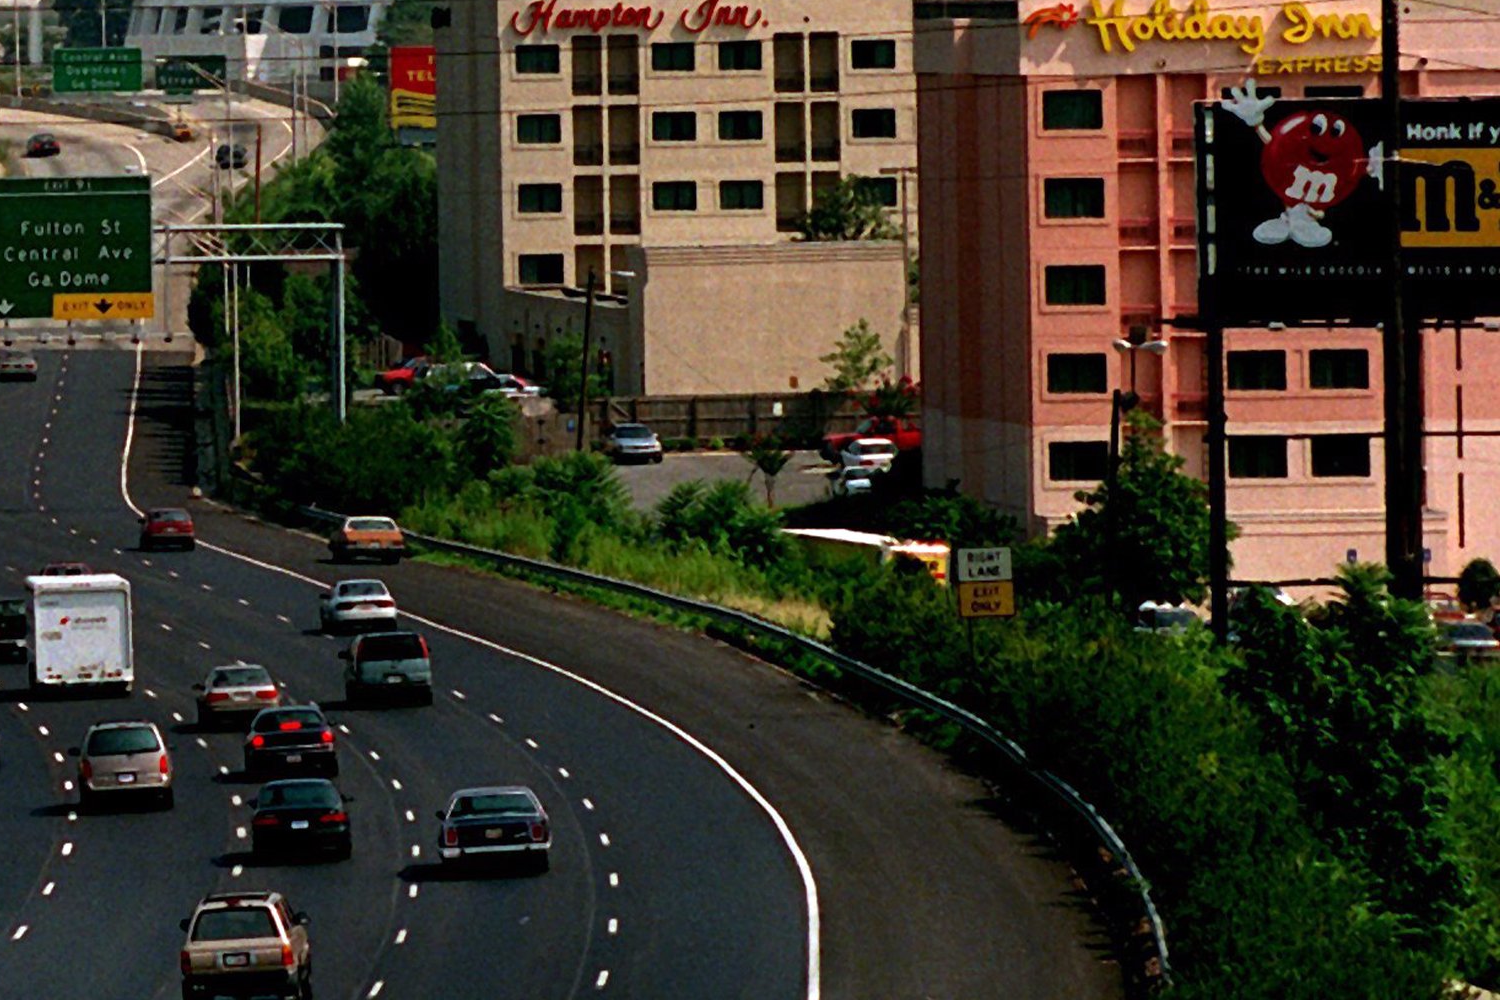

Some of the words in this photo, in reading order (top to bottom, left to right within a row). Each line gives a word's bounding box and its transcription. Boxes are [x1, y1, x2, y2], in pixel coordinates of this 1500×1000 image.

[1282, 1, 1382, 44] Inn
[1256, 54, 1383, 75] EXPRESS
[1405, 122, 1462, 141] Honk
[1284, 164, 1338, 204] m
[20, 220, 85, 236] Fulton
[101, 218, 121, 235] St
[3, 245, 79, 262] Central
[98, 244, 133, 260] Ave
[59, 270, 111, 287] Dome
[62, 301, 91, 313] EXIT
[116, 300, 148, 311] ONLY
[968, 565, 1001, 578] LANE
[971, 600, 1001, 613] ONLY
